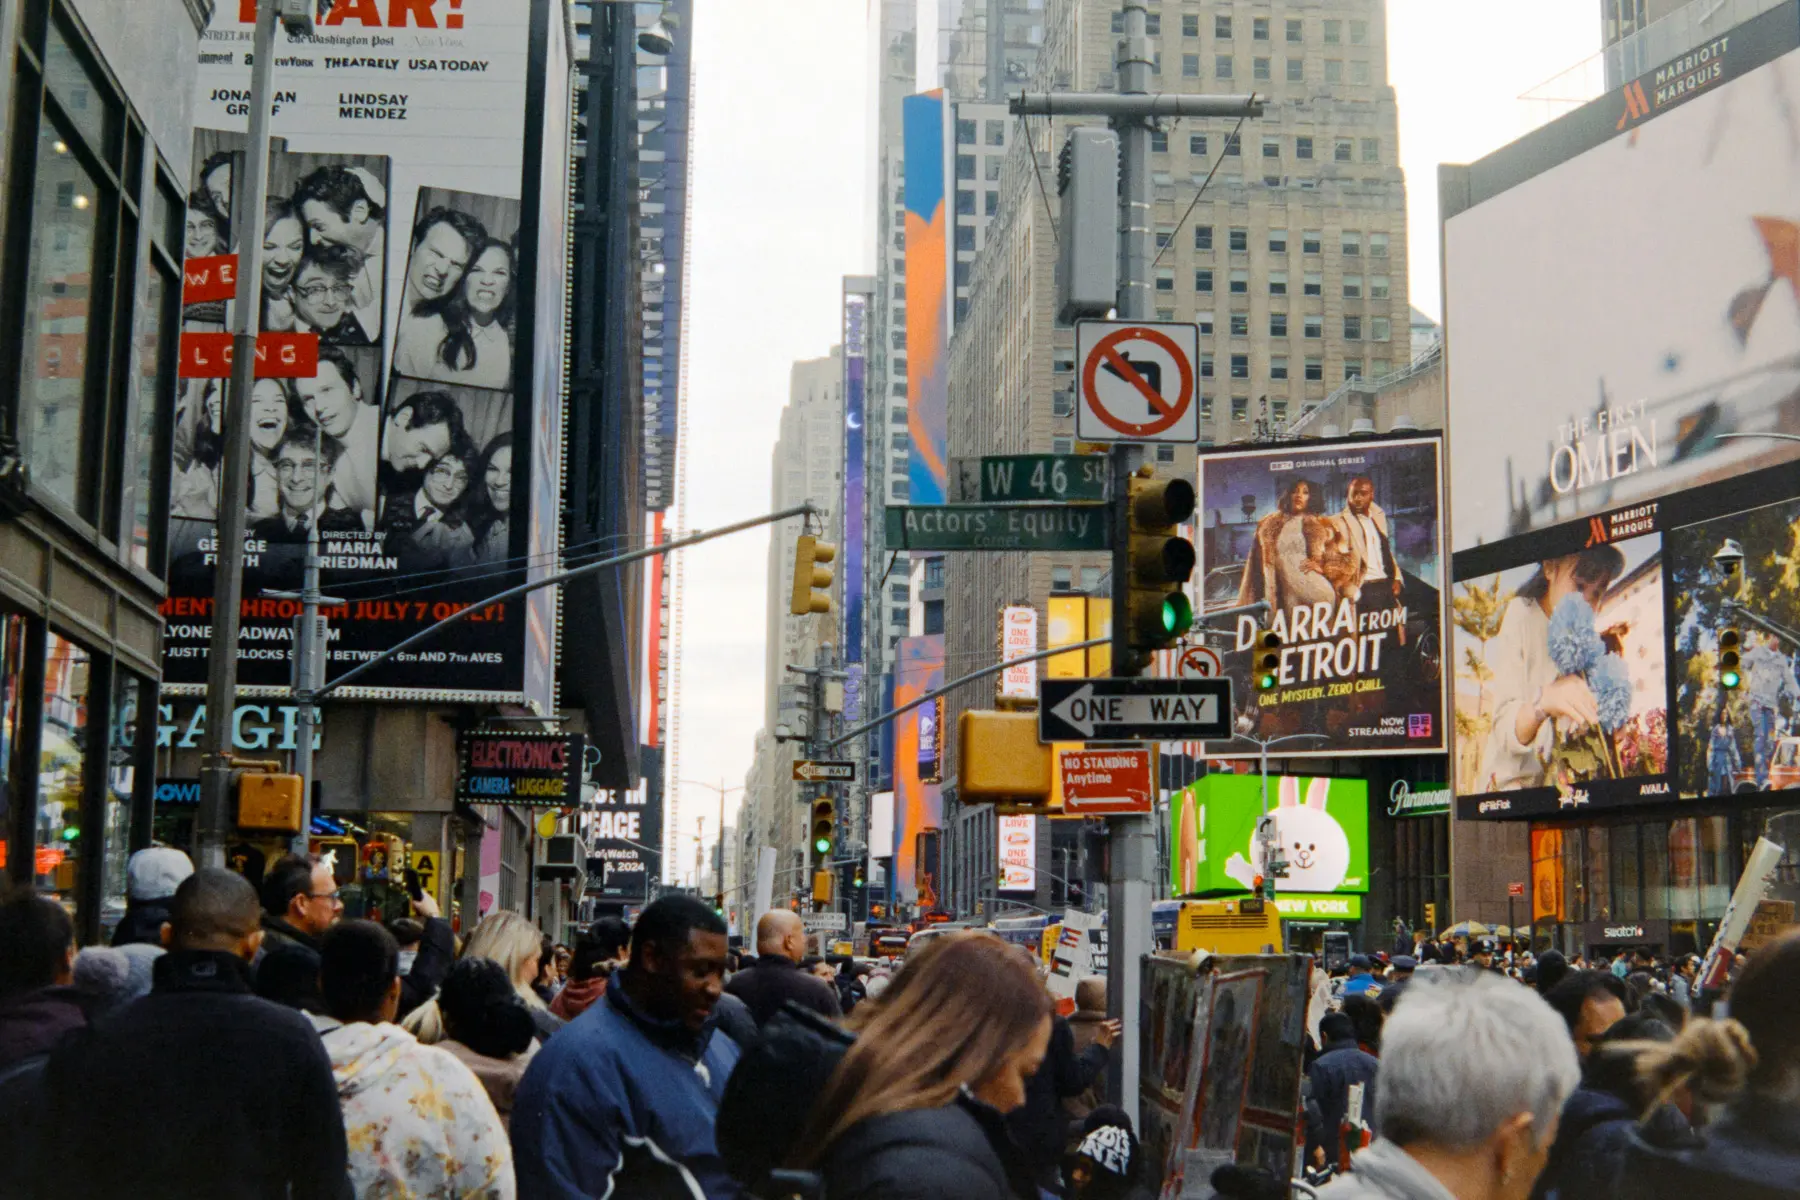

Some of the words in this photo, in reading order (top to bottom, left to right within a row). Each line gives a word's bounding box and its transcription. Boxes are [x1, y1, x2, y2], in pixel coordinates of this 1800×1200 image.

[308, 32, 368, 48] Washington
[372, 36, 394, 48] Post
[324, 57, 400, 70] THEATRELY
[408, 59, 438, 71] USA
[440, 60, 489, 72] TODAY
[1656, 37, 1729, 85] MARRIOTT
[1657, 62, 1721, 104] MARQUIS
[210, 89, 297, 103] JONAAN
[339, 93, 408, 105] LINDSAY
[226, 104, 280, 116] GRF
[339, 107, 407, 120] MENDEZ
[186, 264, 234, 286] WE
[1557, 417, 1589, 443] THE
[1598, 398, 1648, 432] FIRST
[1296, 459, 1336, 468] ORIGINAL
[1338, 456, 1366, 465] SERIES
[1551, 418, 1658, 493] OMEN
[988, 461, 1014, 495] W
[1030, 460, 1068, 493] 46
[1611, 503, 1659, 525] MARRIOTT
[905, 509, 995, 533] Actors'
[1008, 509, 1090, 538] Equity
[1611, 518, 1654, 538] MARQUIS
[322, 531, 372, 540] DIRECTED
[374, 532, 388, 540] BY
[197, 538, 267, 552] GEGE
[327, 541, 382, 554] MARIA
[319, 555, 398, 570] RIEDMAN
[354, 600, 410, 620] JULY
[414, 602, 428, 620] 7
[1358, 606, 1408, 632] FROM
[1011, 628, 1029, 637] ONE
[1008, 637, 1030, 645] LOVE
[168, 646, 200, 657] JUST
[397, 652, 417, 661] 6TH
[419, 652, 446, 662] AND
[449, 652, 468, 662] 7TH
[470, 652, 503, 663] AVES
[1273, 632, 1388, 685] ETROIT
[1008, 675, 1030, 684] LOVE
[1259, 694, 1279, 706] ONE
[1281, 687, 1326, 703] MYSTERY.
[1327, 682, 1353, 697] ZERO
[1070, 698, 1123, 722] ONE
[1150, 698, 1206, 721] WAY
[1381, 717, 1406, 726] NOW
[1348, 727, 1405, 737] STREAMING
[471, 740, 566, 769] ELECTRONICS
[1064, 757, 1081, 769] NO
[1083, 756, 1138, 769] STANDING
[803, 767, 820, 775] ONE
[829, 767, 847, 775] WAY
[470, 776, 511, 795] CAMERA
[516, 777, 565, 796] LUGGAGE
[1067, 773, 1112, 787] Anytime
[580, 811, 640, 839] PEACE
[1005, 819, 1029, 828] LOVE
[1007, 849, 1026, 857] ONE
[617, 861, 645, 872] 2024
[417, 855, 434, 896] AT
[1275, 900, 1308, 912] NEW
[1310, 900, 1349, 913] YORK
[1604, 926, 1637, 938] swatch
